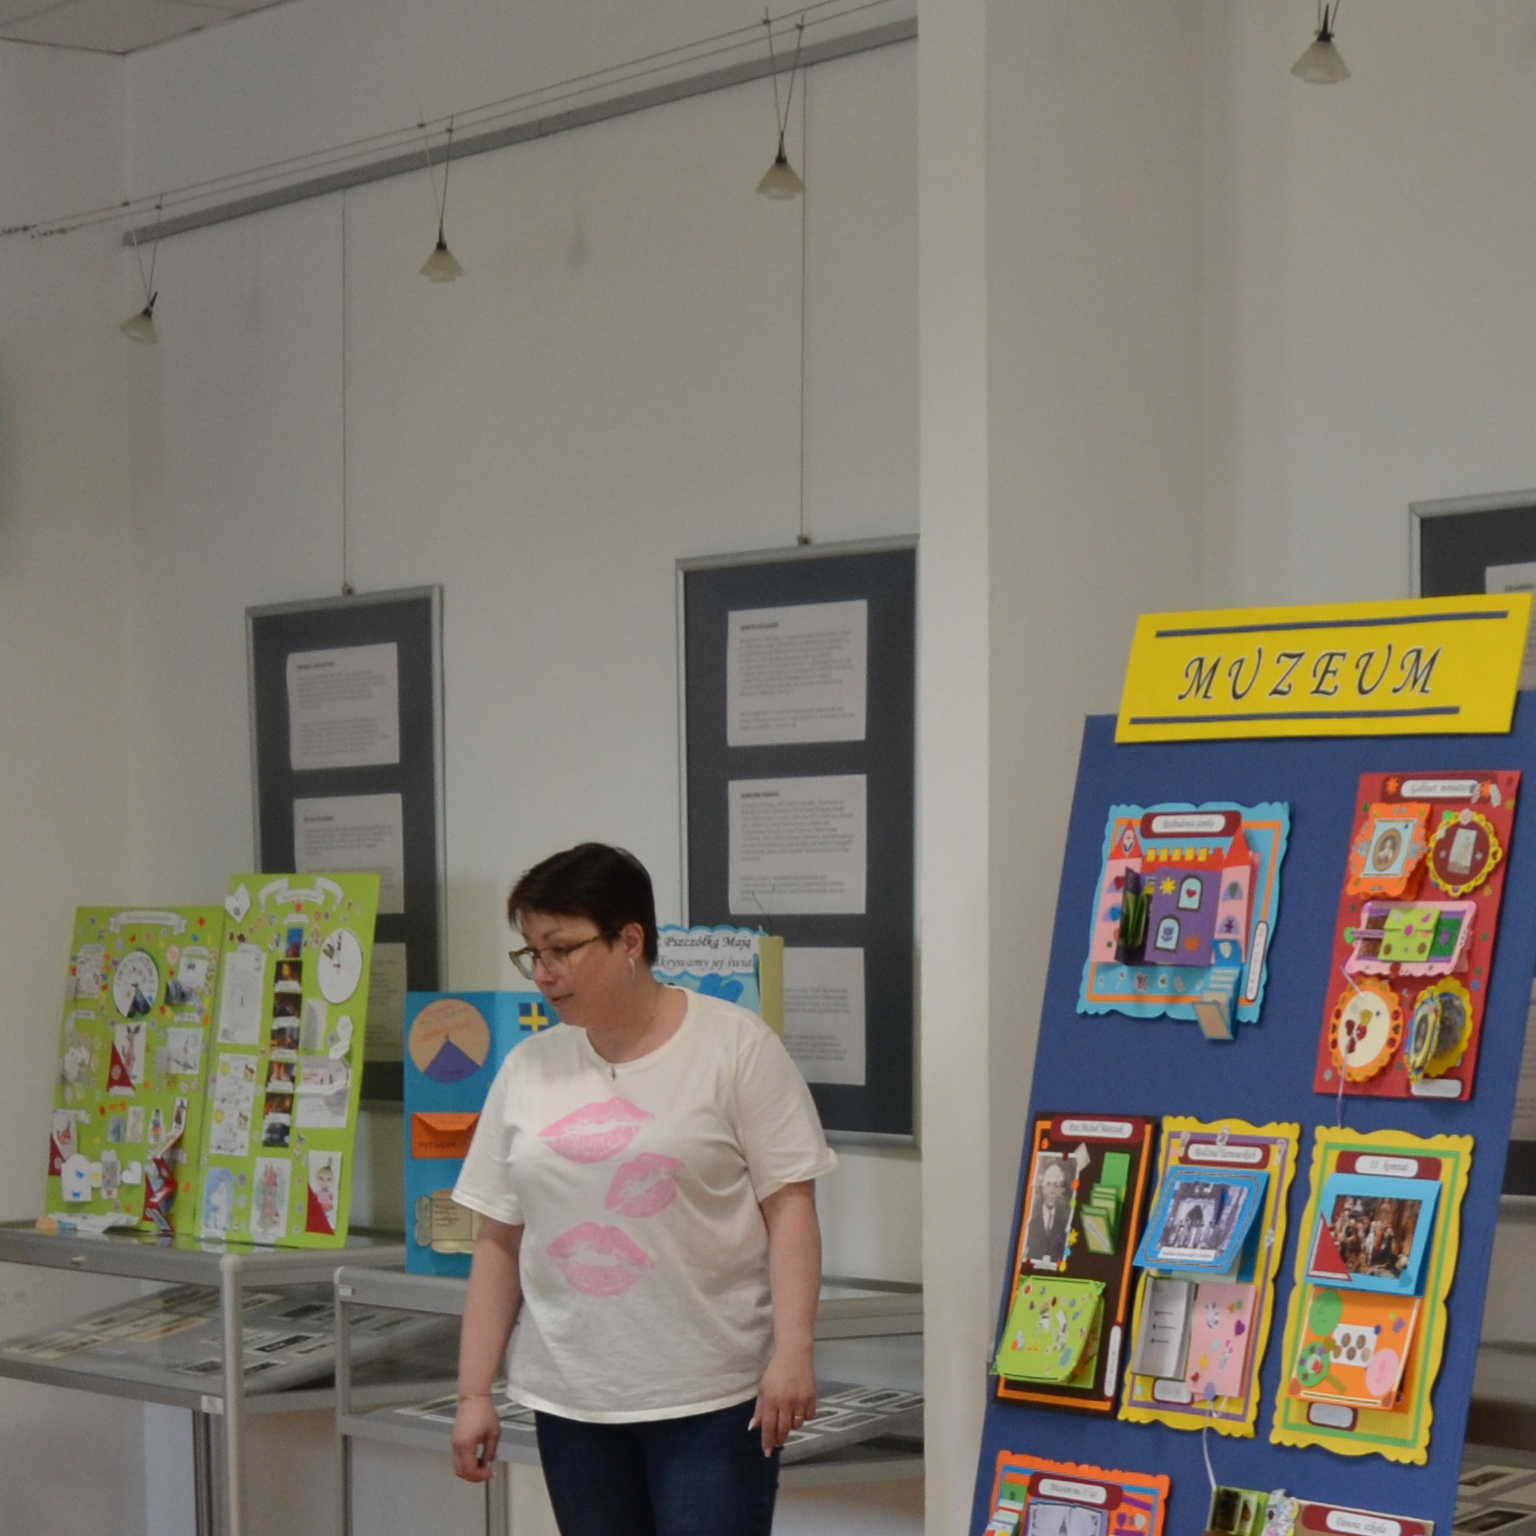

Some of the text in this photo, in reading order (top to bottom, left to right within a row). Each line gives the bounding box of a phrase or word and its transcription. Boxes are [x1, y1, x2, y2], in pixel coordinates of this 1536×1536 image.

[1177, 642, 1443, 701] MUZEUM
[664, 934, 751, 950] Pszczółką Mają
[654, 954, 709, 971] dkrywamy
